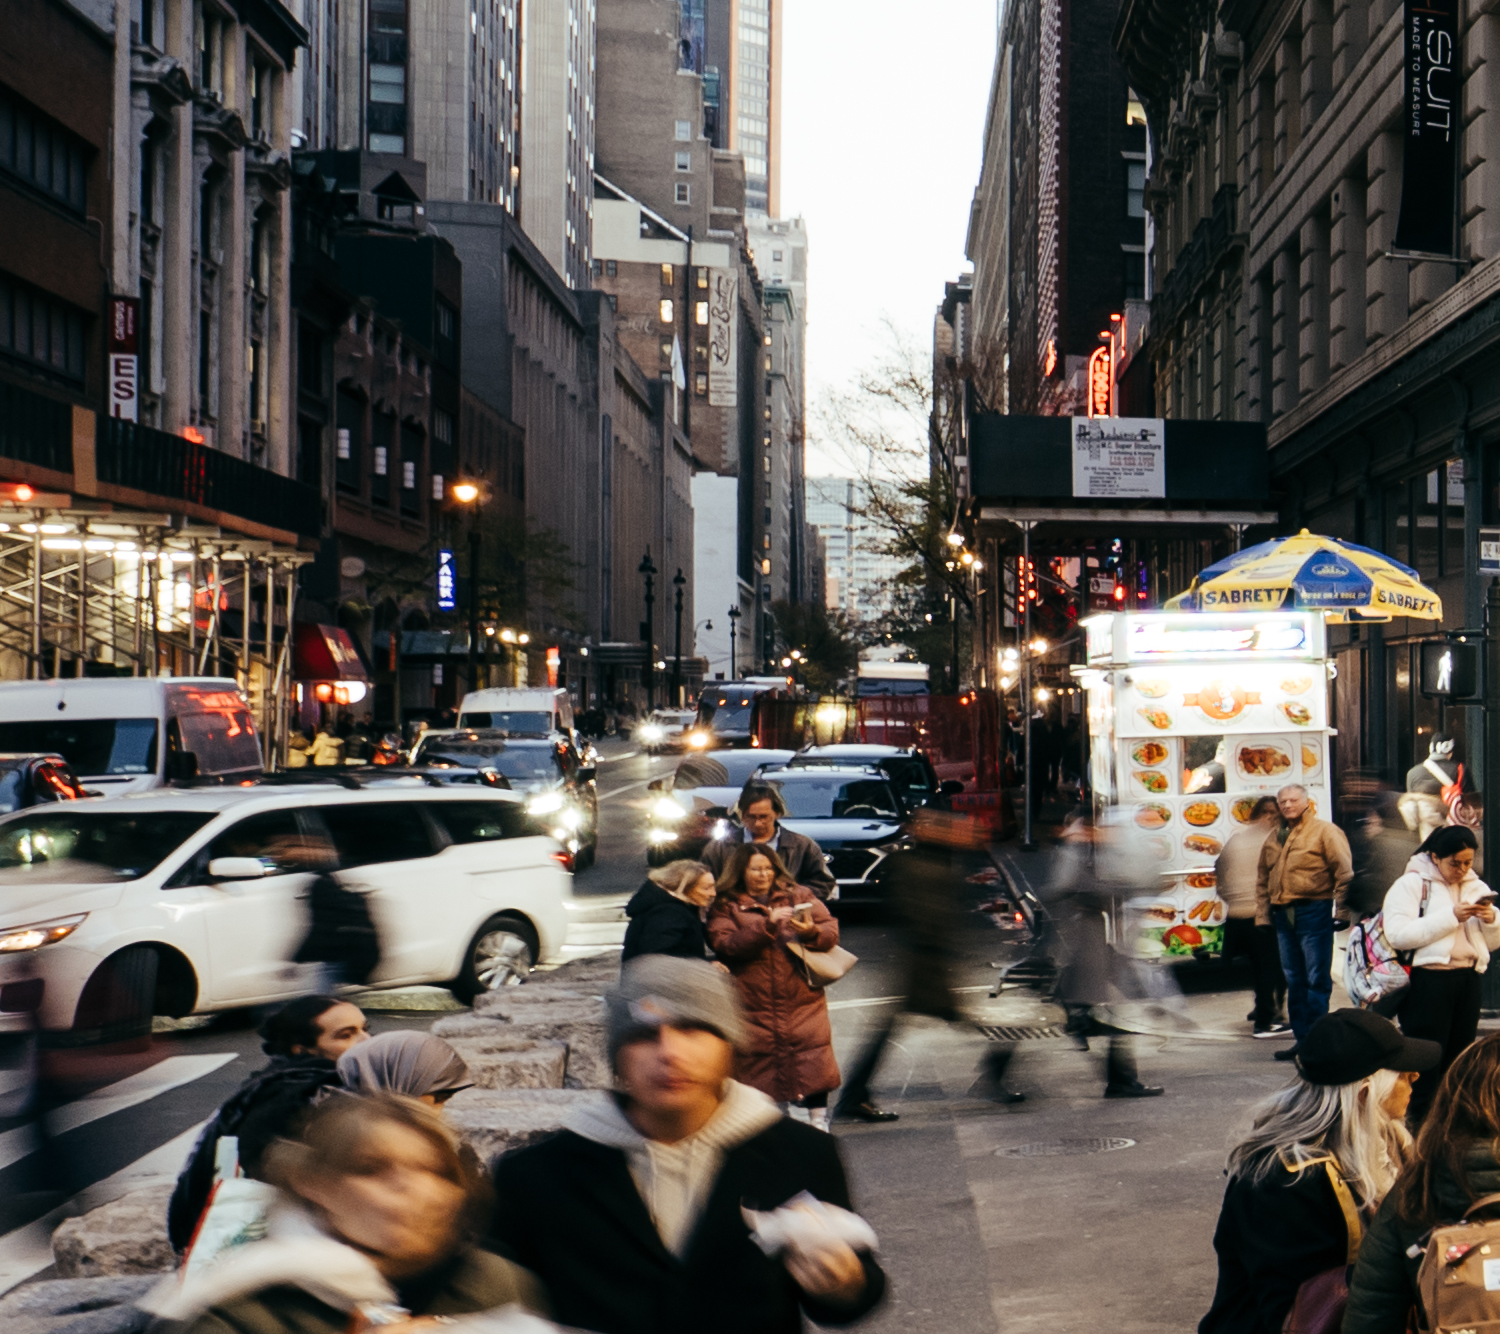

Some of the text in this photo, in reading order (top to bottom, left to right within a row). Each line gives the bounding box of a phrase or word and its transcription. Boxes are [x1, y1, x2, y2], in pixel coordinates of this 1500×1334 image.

[1411, 17, 1421, 137] MADE TO MEASURE
[1204, 587, 1285, 605] SABRETT
[1378, 589, 1435, 613] SABRETT
